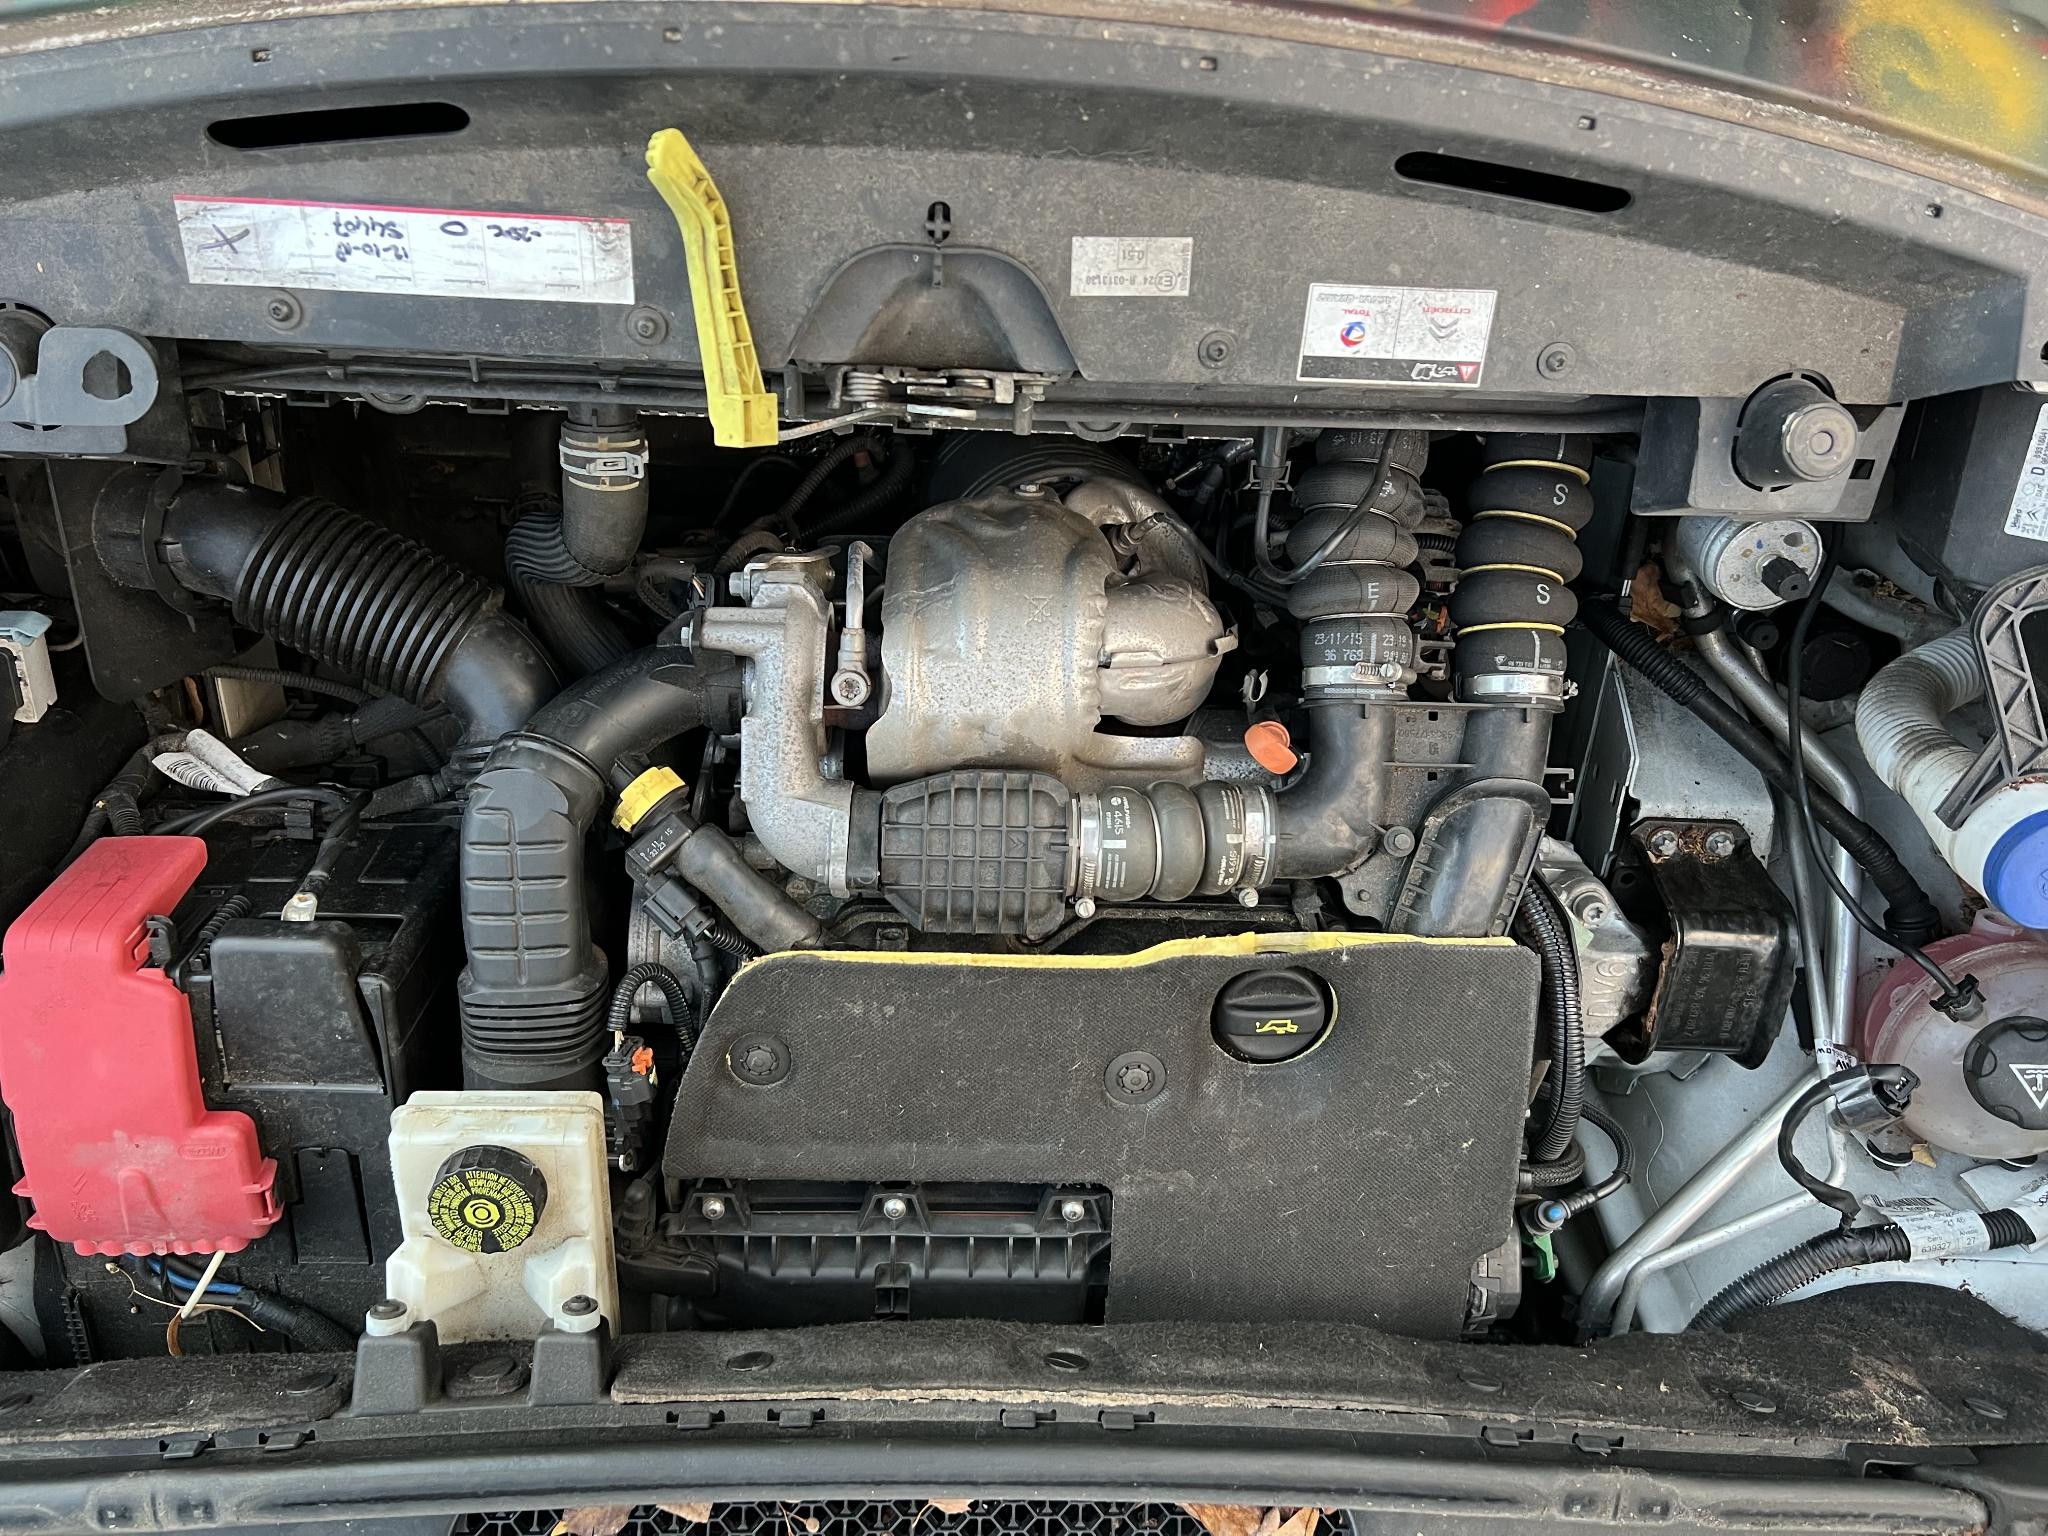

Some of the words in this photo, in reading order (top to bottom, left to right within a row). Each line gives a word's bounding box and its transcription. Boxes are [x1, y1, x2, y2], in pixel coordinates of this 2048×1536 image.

[1342, 308, 1371, 317] TOTAL
[1553, 484, 1568, 505] S
[1536, 583, 1550, 604] S
[466, 1171, 498, 1180] ATTENTION
[453, 1182, 466, 1192] CAP
[449, 1209, 464, 1227] CLEAN
[460, 1225, 483, 1238] FILLER
[432, 1219, 452, 1239] SEALED
[449, 1235, 482, 1252] CONTAINER
[454, 1230, 466, 1240] USE
